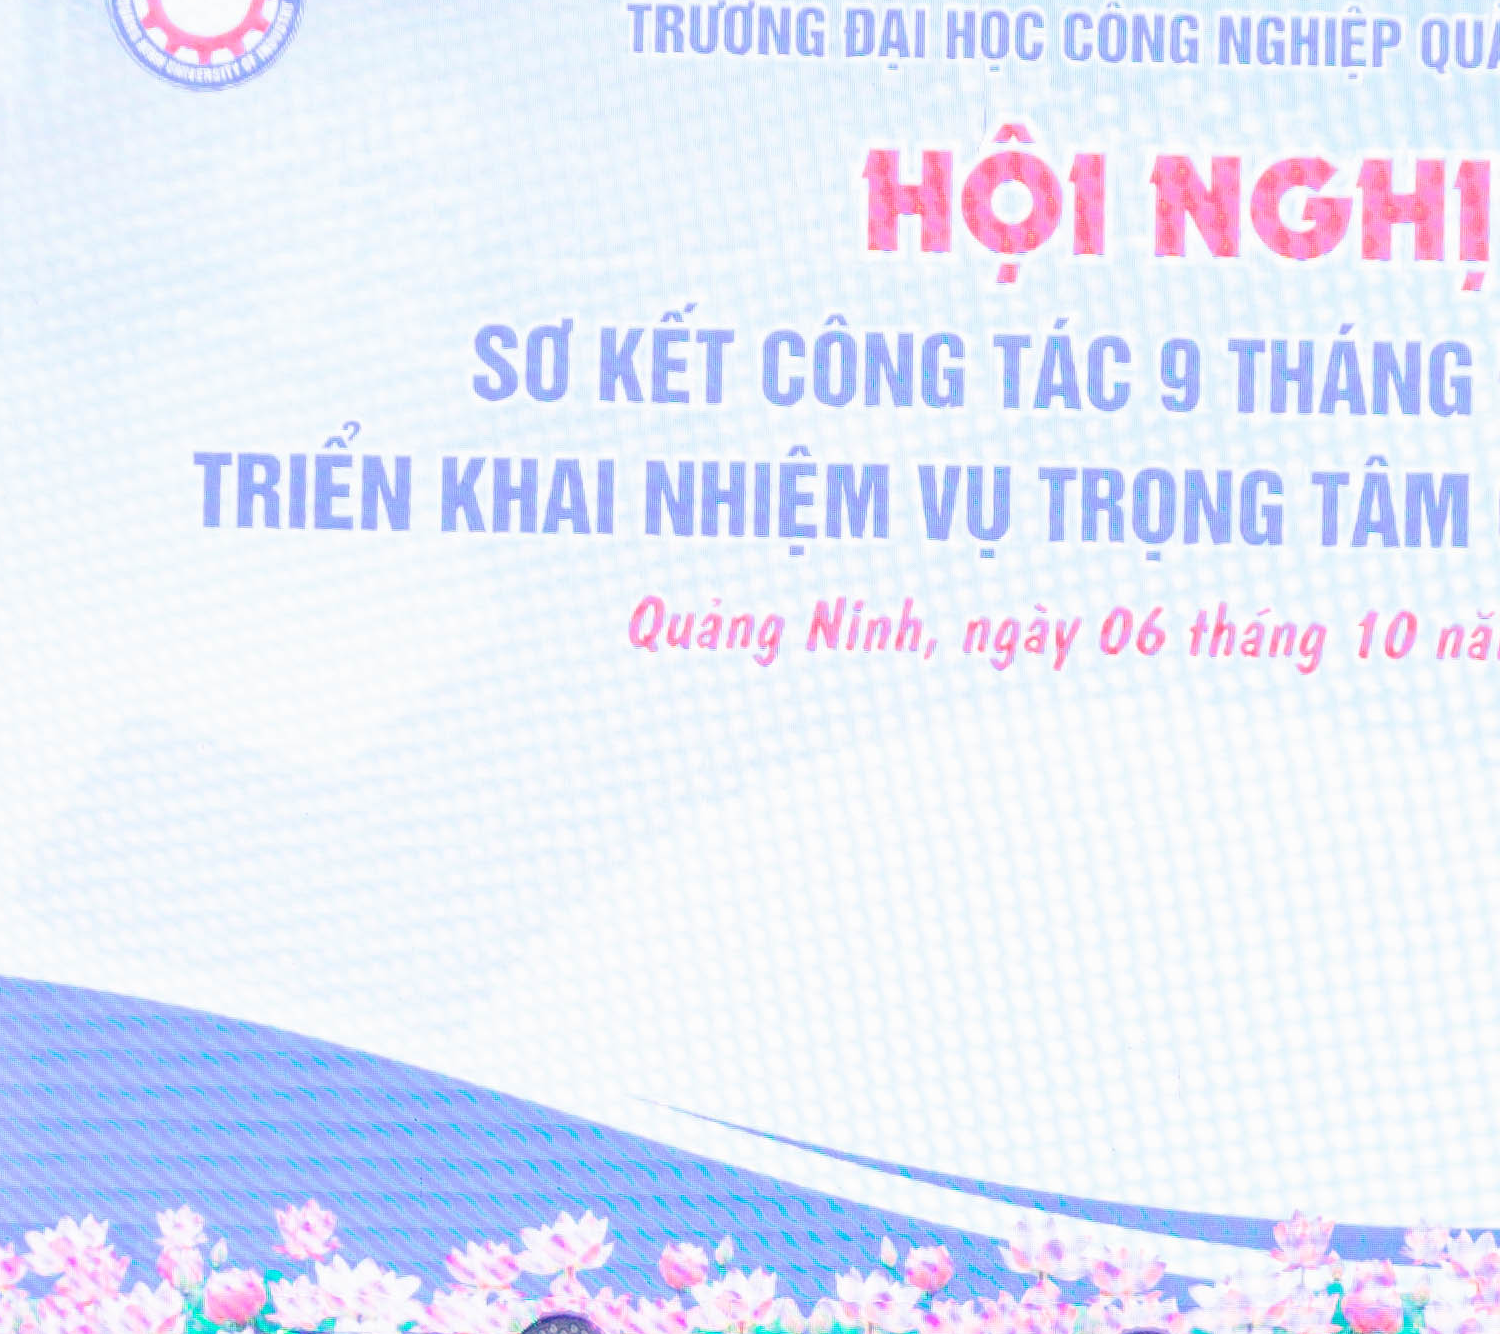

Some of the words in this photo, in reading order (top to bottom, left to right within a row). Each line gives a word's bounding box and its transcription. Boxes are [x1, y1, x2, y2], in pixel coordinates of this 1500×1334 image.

[844, 5, 927, 70] ĐẠI
[945, 9, 1044, 72] HỌC
[1063, 1, 1199, 64] CÔNG
[1217, 5, 1402, 80] NGHIỆP
[863, 123, 1105, 284] HỘI
[1152, 154, 1491, 292] NGHỊ
[473, 320, 572, 402] SƠ
[599, 304, 734, 405] KẾT
[761, 315, 966, 408] CÔNG
[992, 319, 1131, 413] TÁC
[1161, 337, 1201, 412] 9
[1228, 323, 1473, 418] THÁNG
[193, 421, 413, 531] TRIỂN
[441, 456, 615, 534] KHAI
[644, 445, 889, 556] NHIỆM
[916, 465, 1011, 559] VỤ
[1038, 466, 1284, 562] TRỌNG
[1311, 457, 1469, 547] TÂM
[628, 595, 784, 667] Quảng
[804, 596, 937, 658] Ninh,
[962, 603, 1079, 671] ngày
[1100, 607, 1165, 657] 06
[1188, 601, 1327, 675] tháng
[1358, 611, 1416, 661] 10
